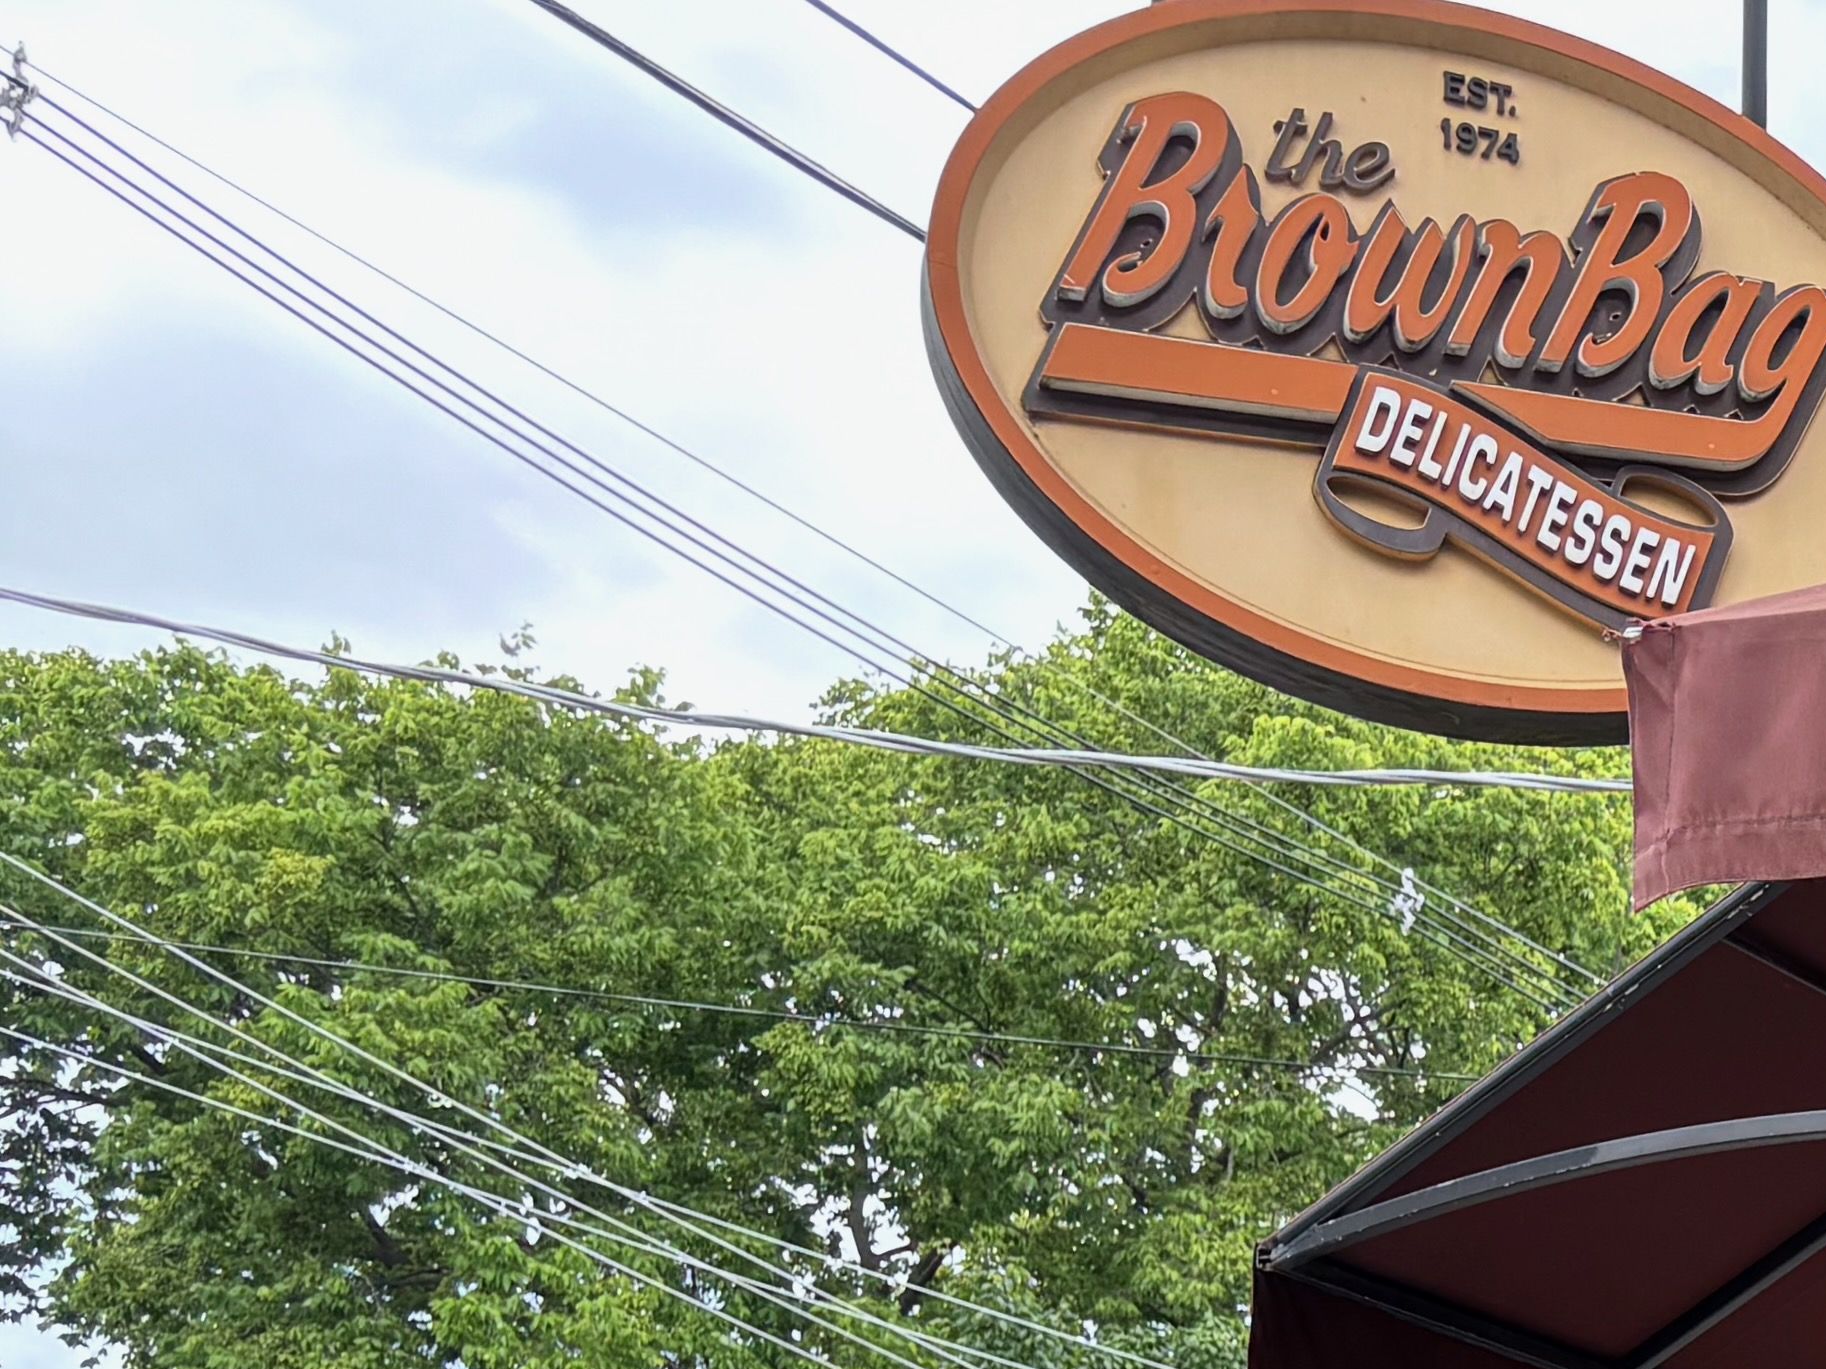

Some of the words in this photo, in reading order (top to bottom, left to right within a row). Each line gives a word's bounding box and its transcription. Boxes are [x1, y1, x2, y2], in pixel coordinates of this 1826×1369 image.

[1443, 70, 1517, 117] EST.
[1265, 107, 1396, 192] the
[1440, 117, 1520, 166] 1974
[1354, 384, 1696, 609] DELICATESSEN
